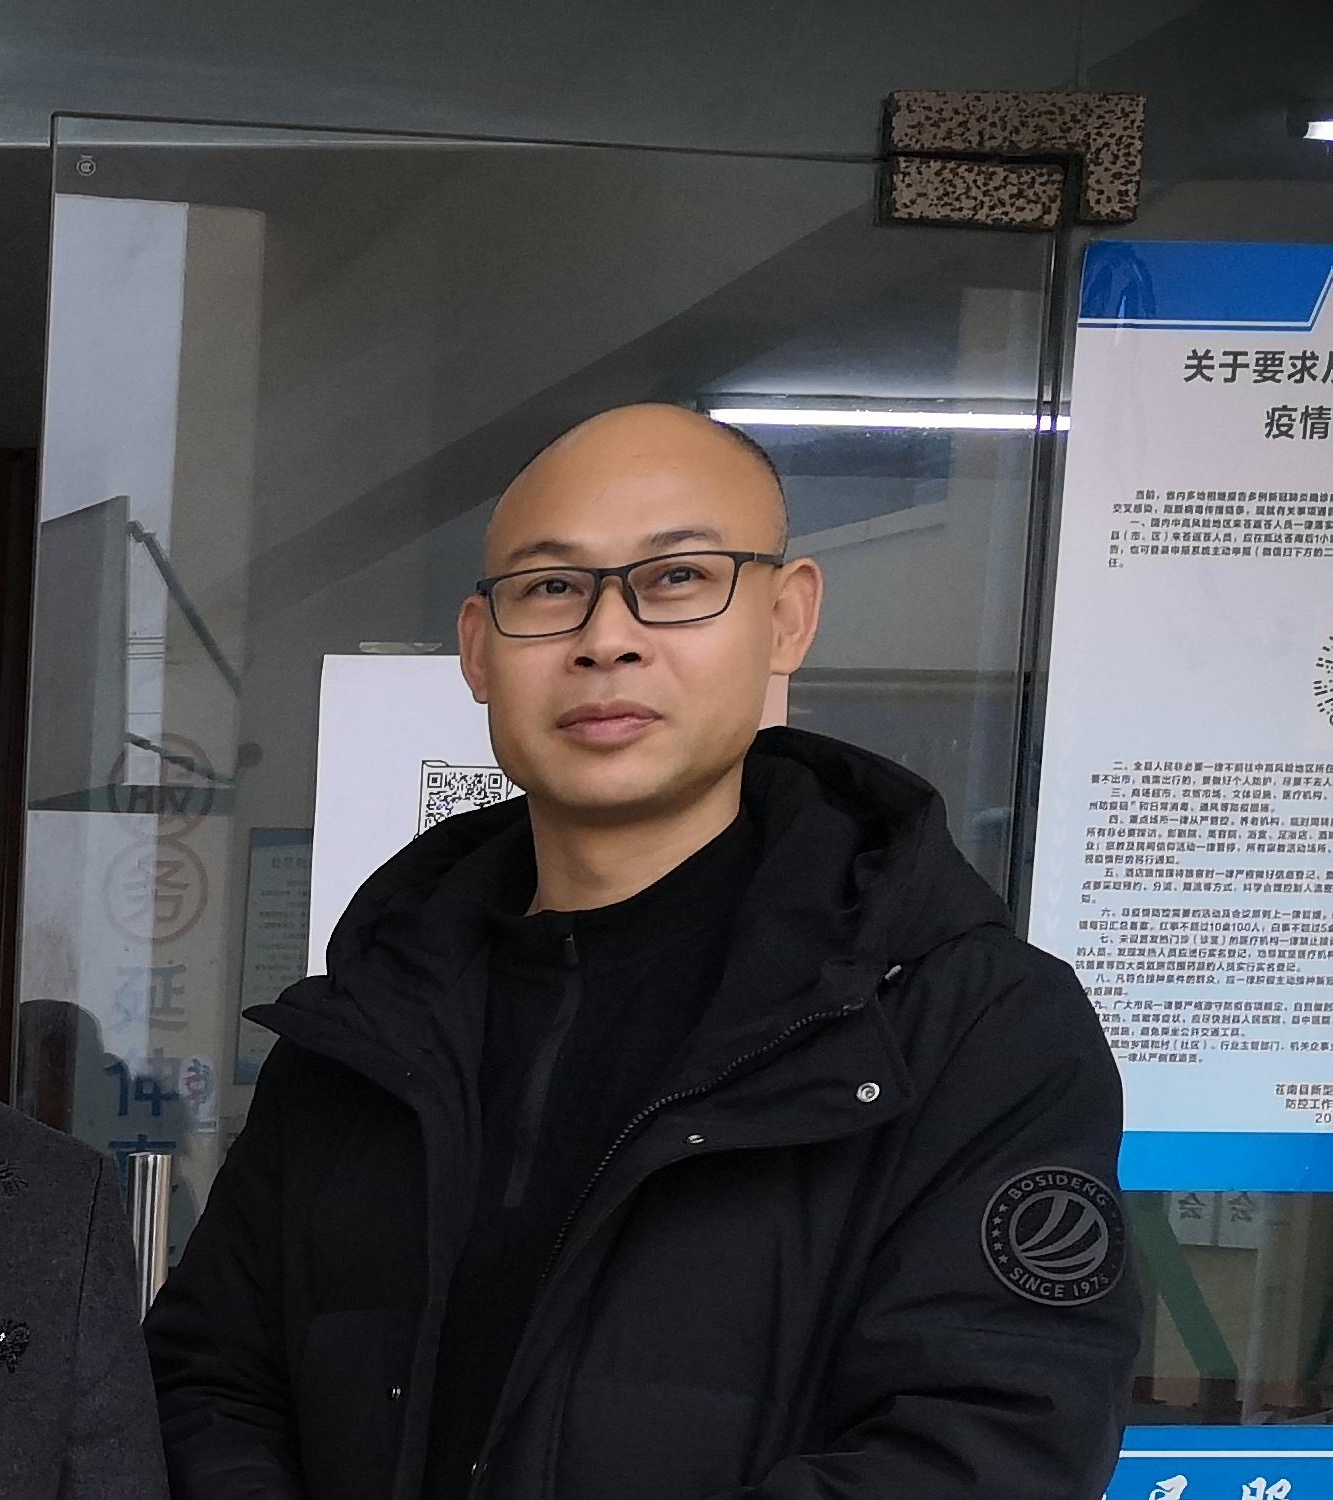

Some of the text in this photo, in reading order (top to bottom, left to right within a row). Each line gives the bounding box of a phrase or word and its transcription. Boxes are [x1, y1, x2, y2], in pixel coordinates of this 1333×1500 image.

[1265, 404, 1332, 440] 疫情
[1008, 1174, 1109, 1207] BOSIDENG
[1010, 1267, 1065, 1297] SINCE
